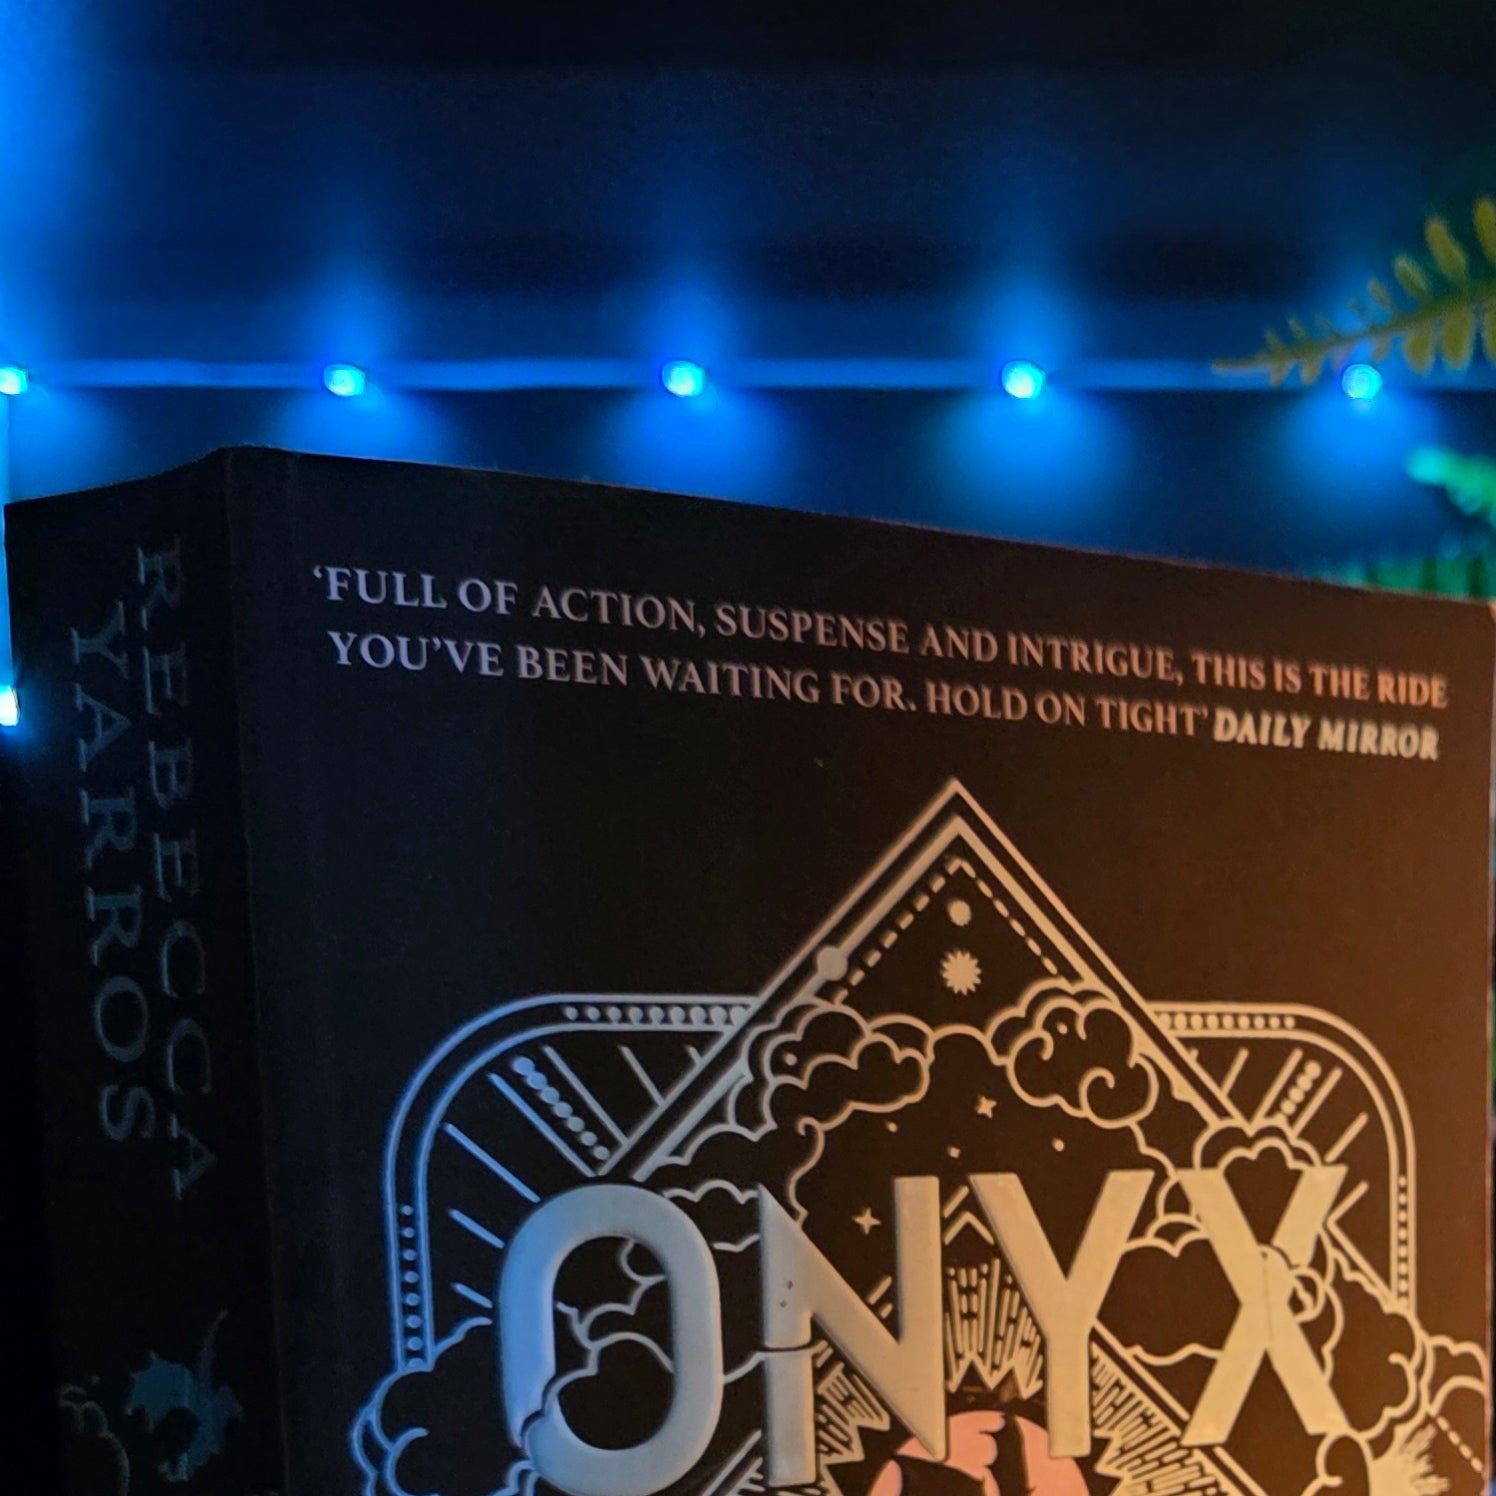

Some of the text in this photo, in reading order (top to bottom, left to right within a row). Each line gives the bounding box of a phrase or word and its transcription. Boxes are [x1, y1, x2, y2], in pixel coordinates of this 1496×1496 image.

[327, 631, 504, 677] YOU’VE
[516, 644, 628, 686] BEEN
[640, 655, 820, 704] WAITING
[831, 671, 917, 714] FOR.
[926, 680, 1028, 723] HOLD
[1036, 688, 1087, 728] ON
[1213, 706, 1311, 748] DAILY
[1317, 718, 1439, 761] MIRROR
[458, 578, 518, 615] OF
[531, 585, 706, 638] ACTION,
[714, 602, 909, 655] SUSPENSE
[920, 625, 998, 663] AND
[1007, 631, 1184, 686] INTRIGUE,
[1190, 648, 1267, 691] THIS
[1273, 655, 1301, 695] IS
[1308, 662, 1370, 702] THE
[1377, 669, 1448, 709] RIDE
[70, 601, 155, 1143] YARROS
[136, 534, 218, 1200] REBECCA
